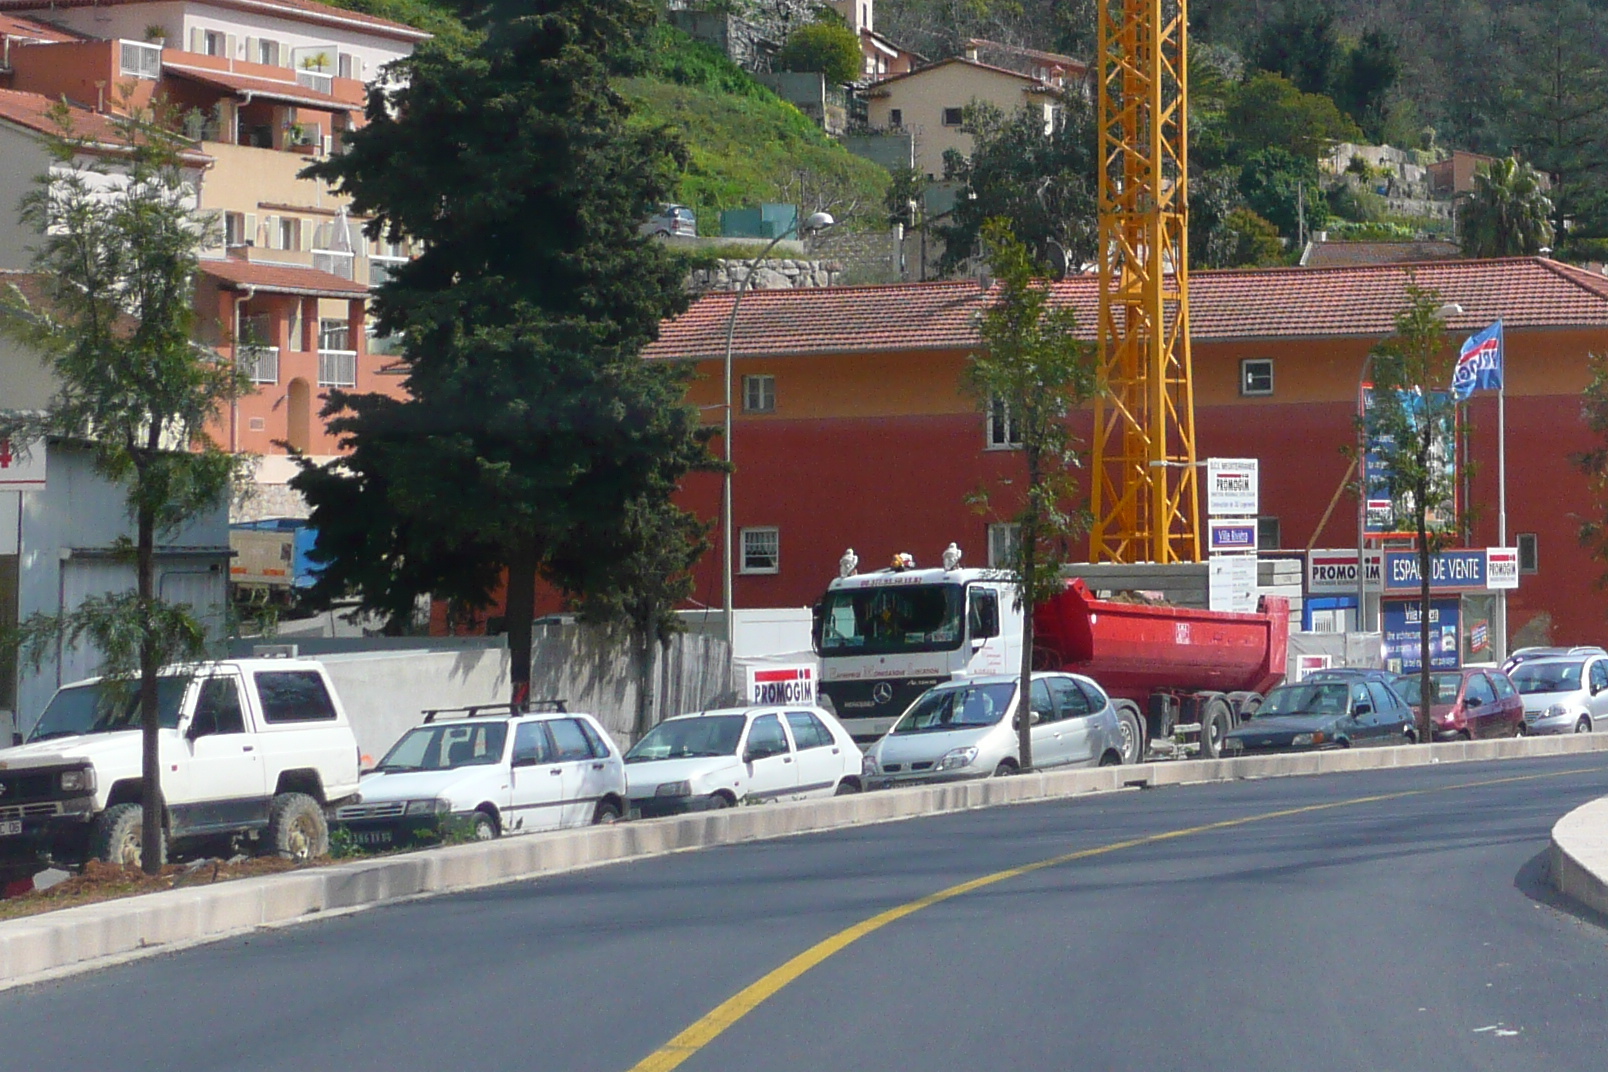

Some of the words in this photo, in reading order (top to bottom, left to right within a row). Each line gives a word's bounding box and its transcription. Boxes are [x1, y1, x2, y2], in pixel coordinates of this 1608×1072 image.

[1216, 479, 1250, 491] PROMOGIM
[1433, 558, 1446, 580] DE
[1448, 558, 1480, 579] VENTE
[755, 681, 812, 704] PROMOGIM
